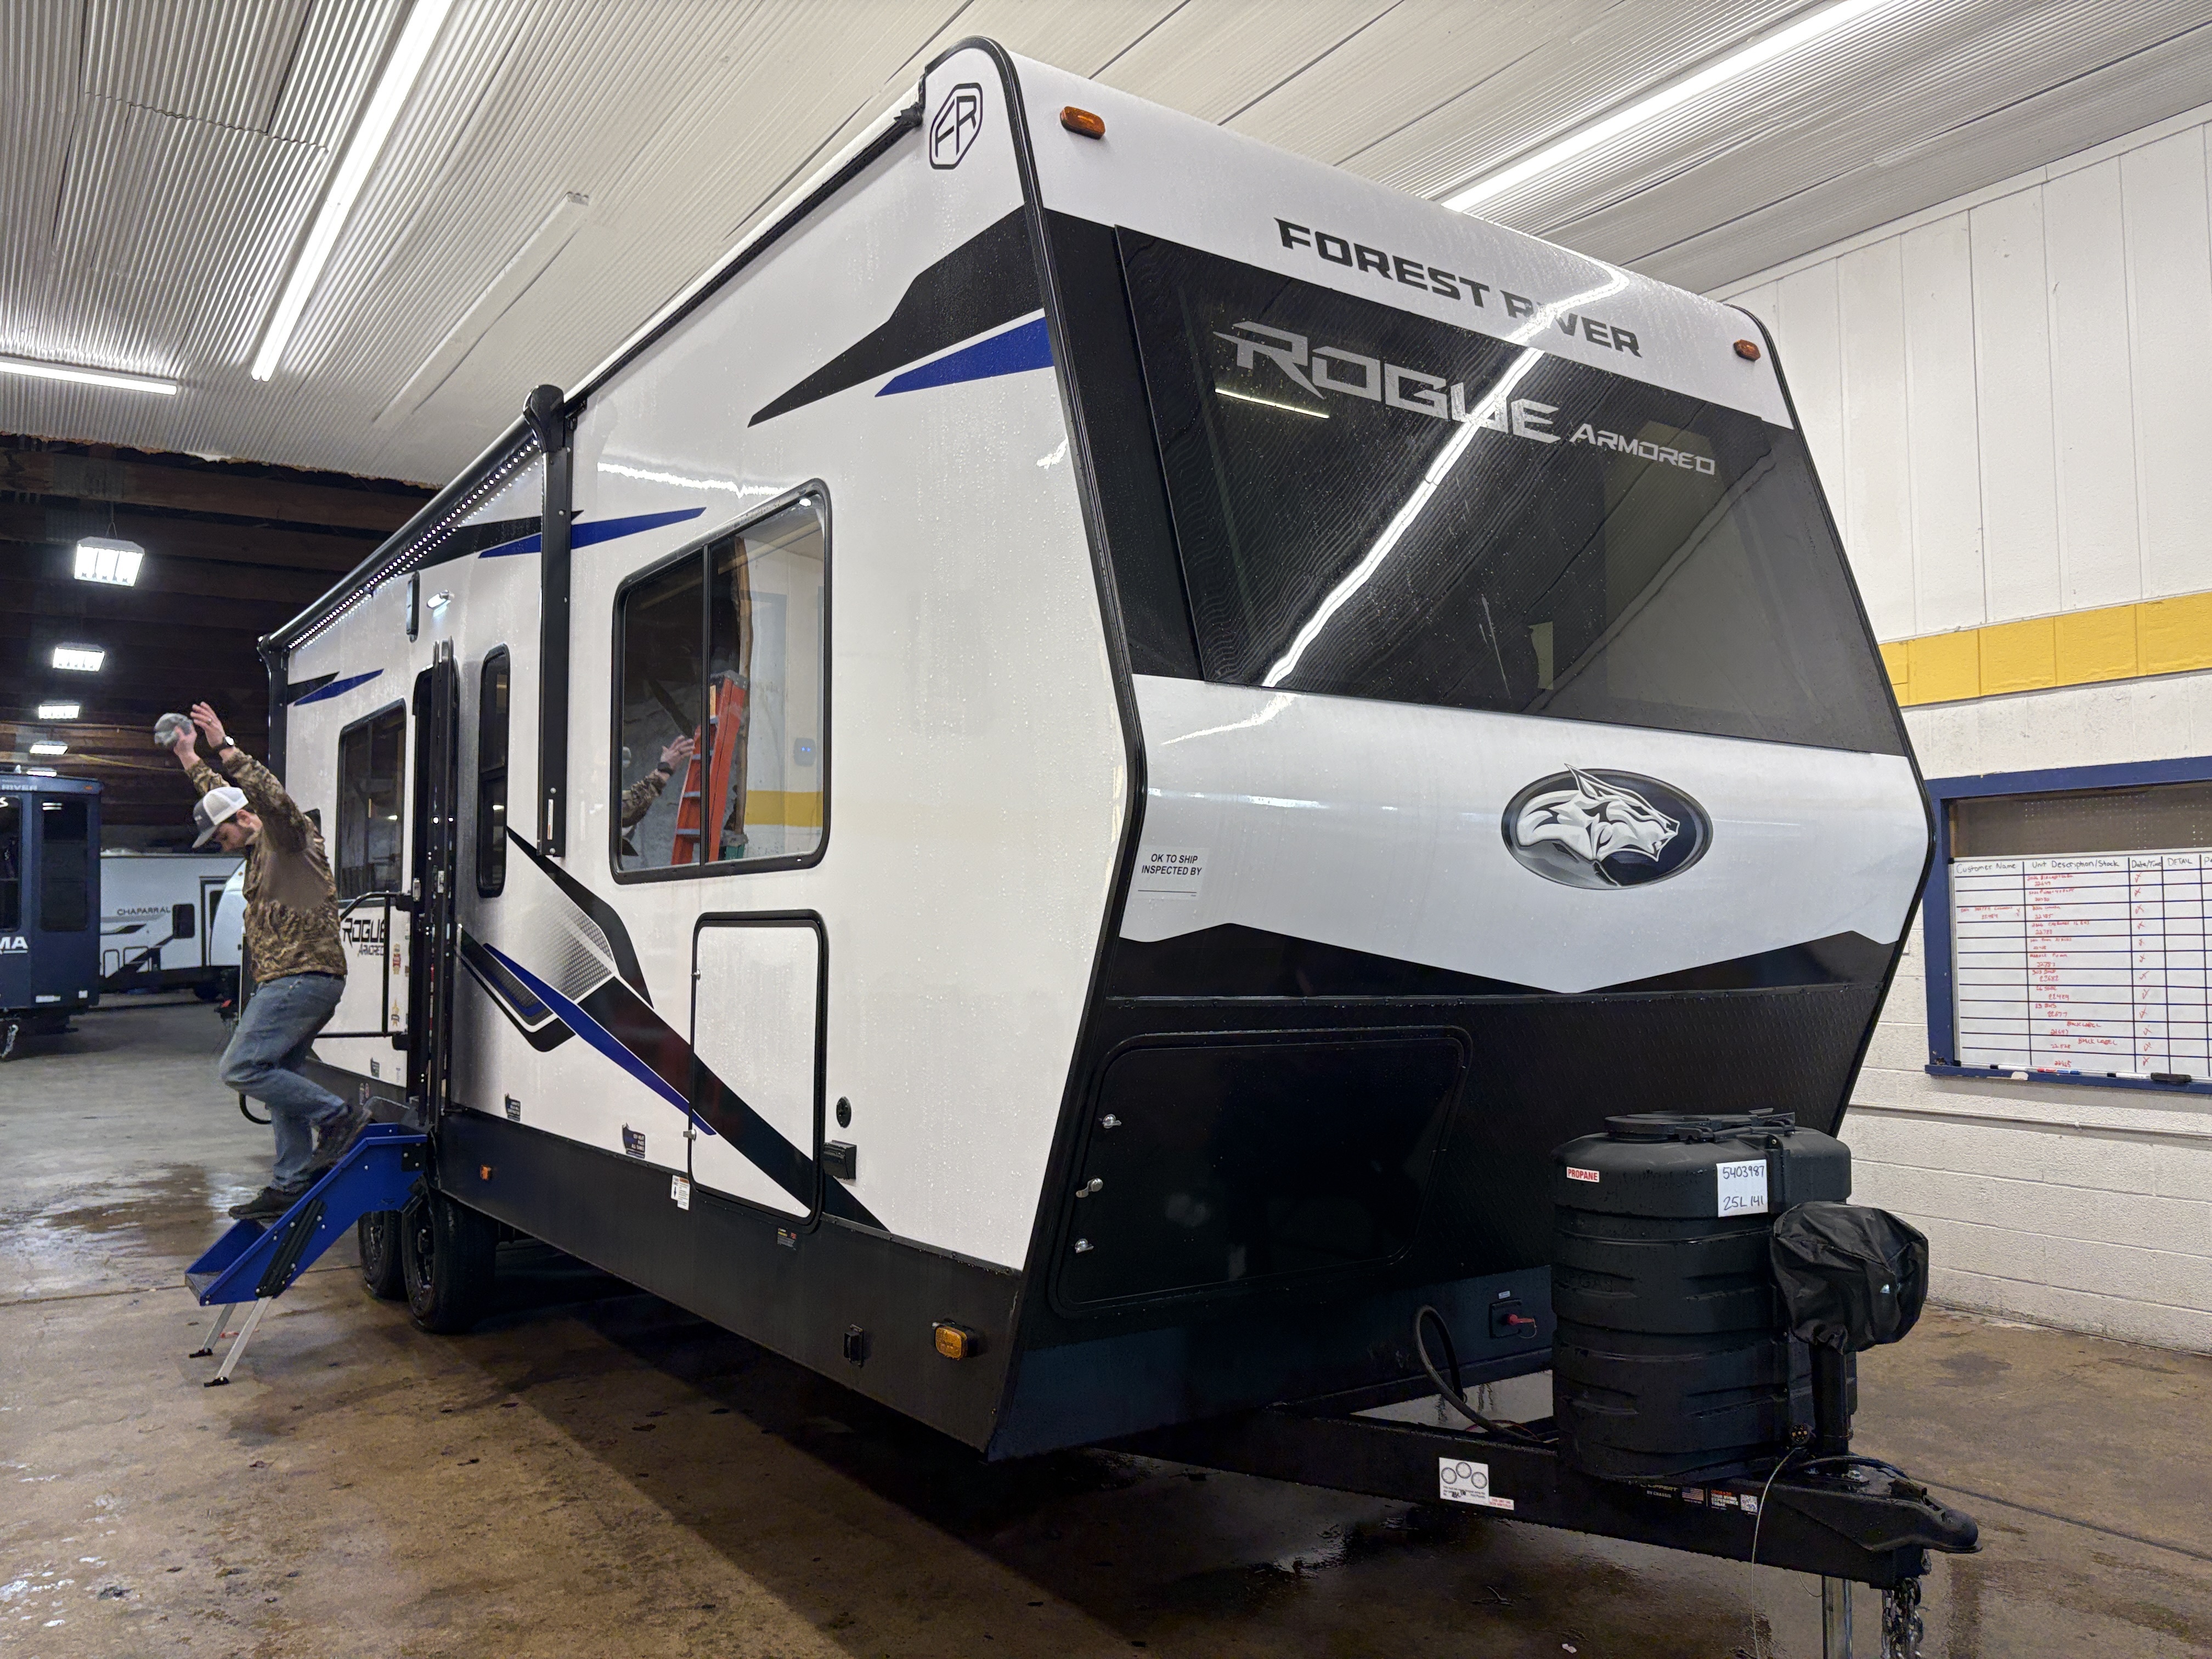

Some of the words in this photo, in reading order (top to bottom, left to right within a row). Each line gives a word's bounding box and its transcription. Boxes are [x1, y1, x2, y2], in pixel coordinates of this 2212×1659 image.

[1273, 217, 1490, 308] FOREST
[1212, 320, 1561, 444] ROGUE
[1568, 423, 1716, 476] ARMORED
[1151, 853, 1164, 863] OK
[1166, 854, 1177, 863] TO
[1178, 855, 1198, 864] SHIP
[2168, 857, 2193, 866] DETAIL
[1141, 865, 1189, 875] INSPECTED
[1190, 867, 1203, 876] BY
[1956, 864, 1992, 873] Customer
[116, 907, 171, 916] CHAPARRAL
[1568, 1168, 1598, 1181] PROPANE
[1723, 1165, 1765, 1180] 5403987
